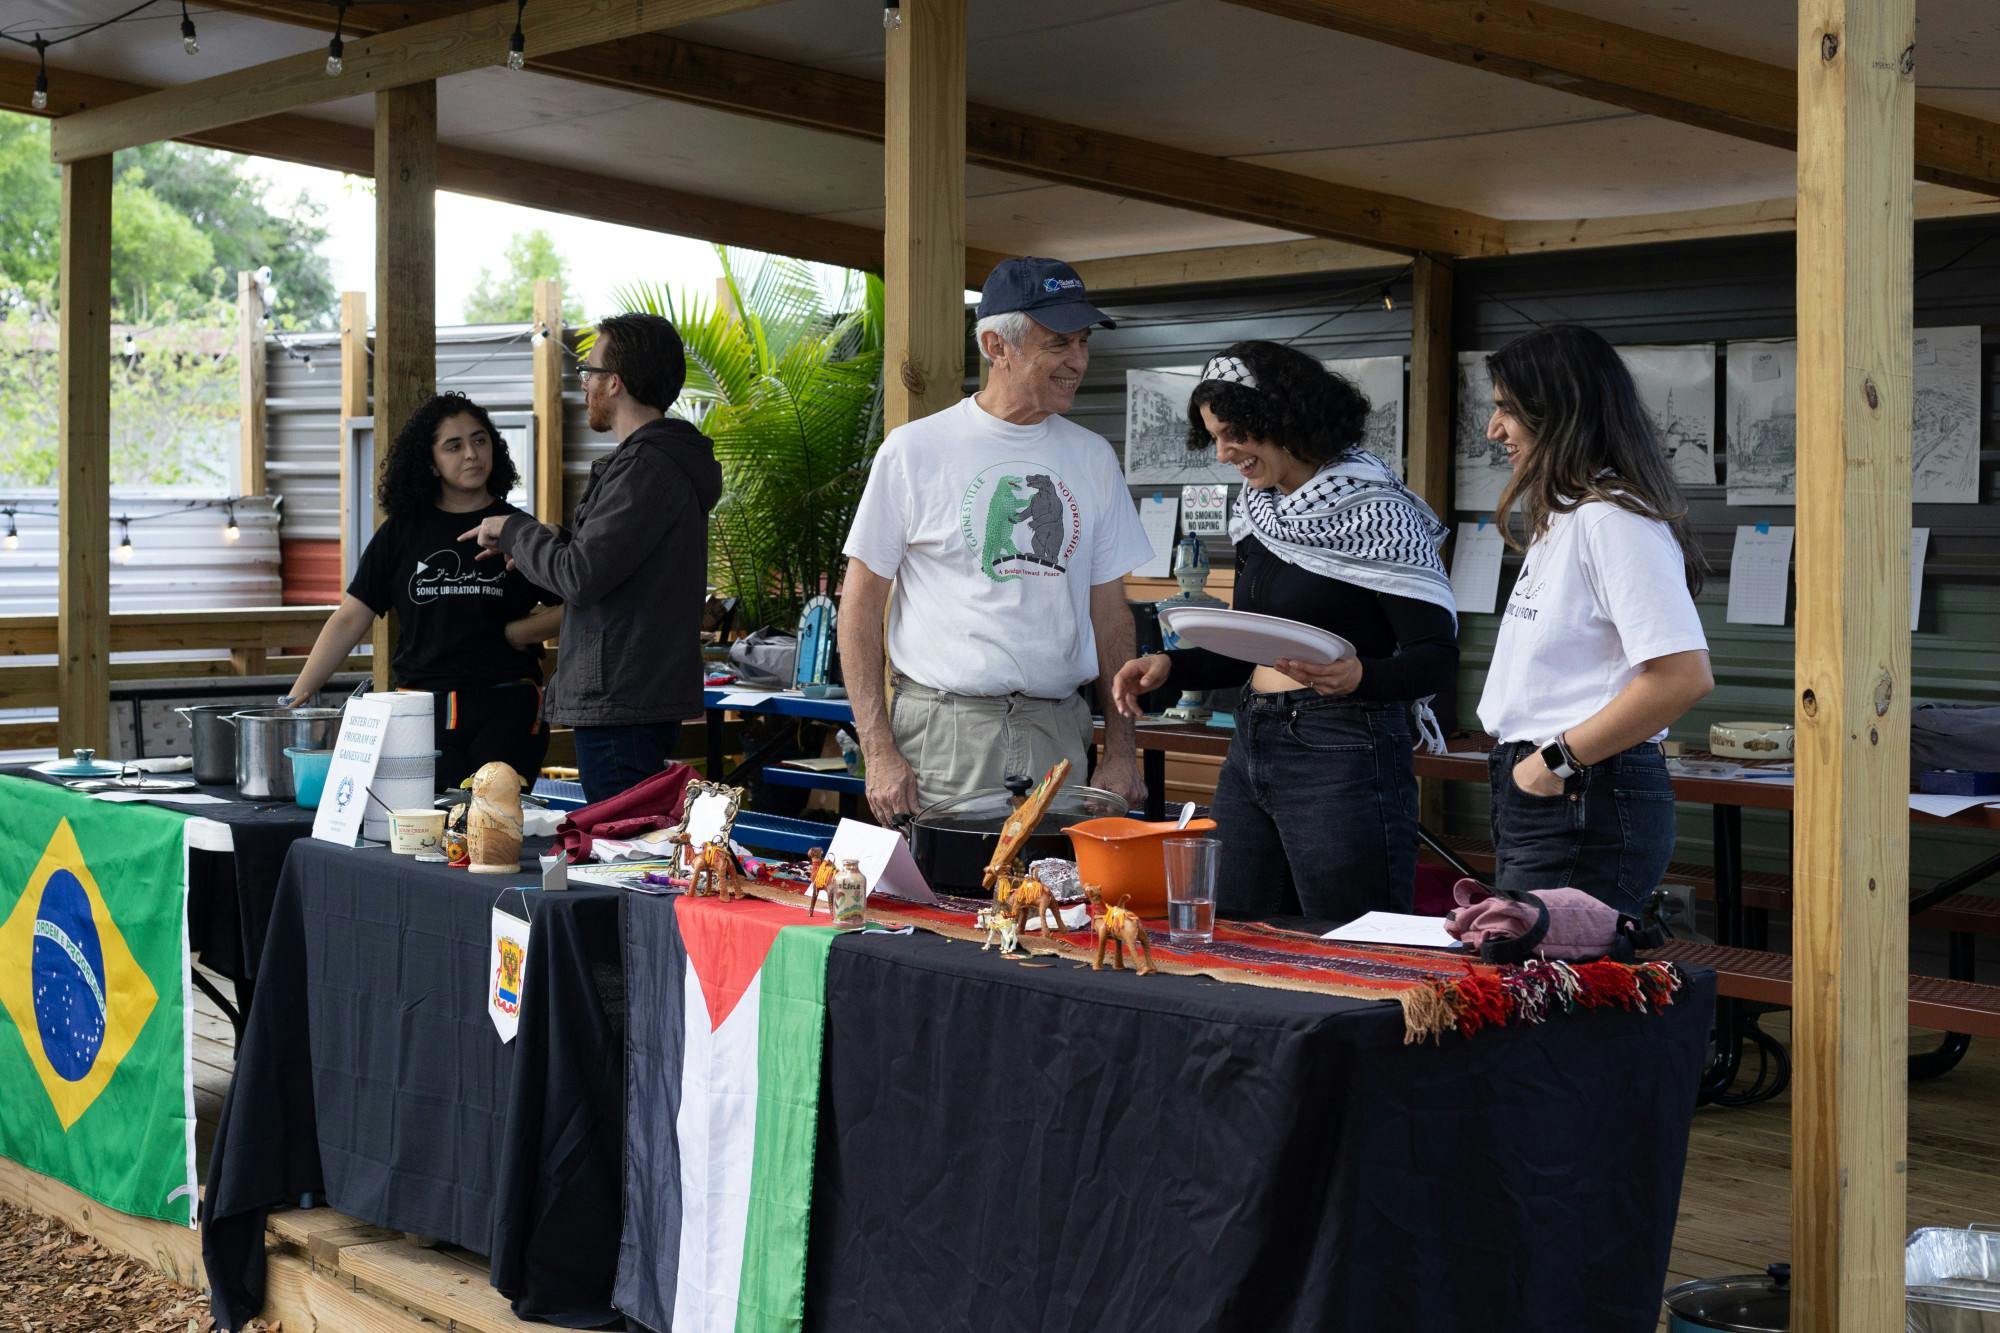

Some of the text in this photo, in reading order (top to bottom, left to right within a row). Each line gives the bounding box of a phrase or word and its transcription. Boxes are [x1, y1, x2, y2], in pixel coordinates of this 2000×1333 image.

[962, 476, 986, 548] GAINESVILLE
[1185, 511, 1194, 520] NO
[1195, 510, 1222, 520] SMOKING
[1188, 521, 1220, 530] NO VAPING
[1004, 567, 1022, 575] Bridge
[1022, 568, 1040, 577] Toward
[416, 586, 439, 596] SONIC
[440, 585, 480, 595] LIBERATION
[367, 718, 380, 729] CITY
[344, 731, 369, 744] PROGRAM
[339, 749, 373, 763] GAINESVILLE
[36, 921, 105, 1013] ORDEM E PROGRESSO
